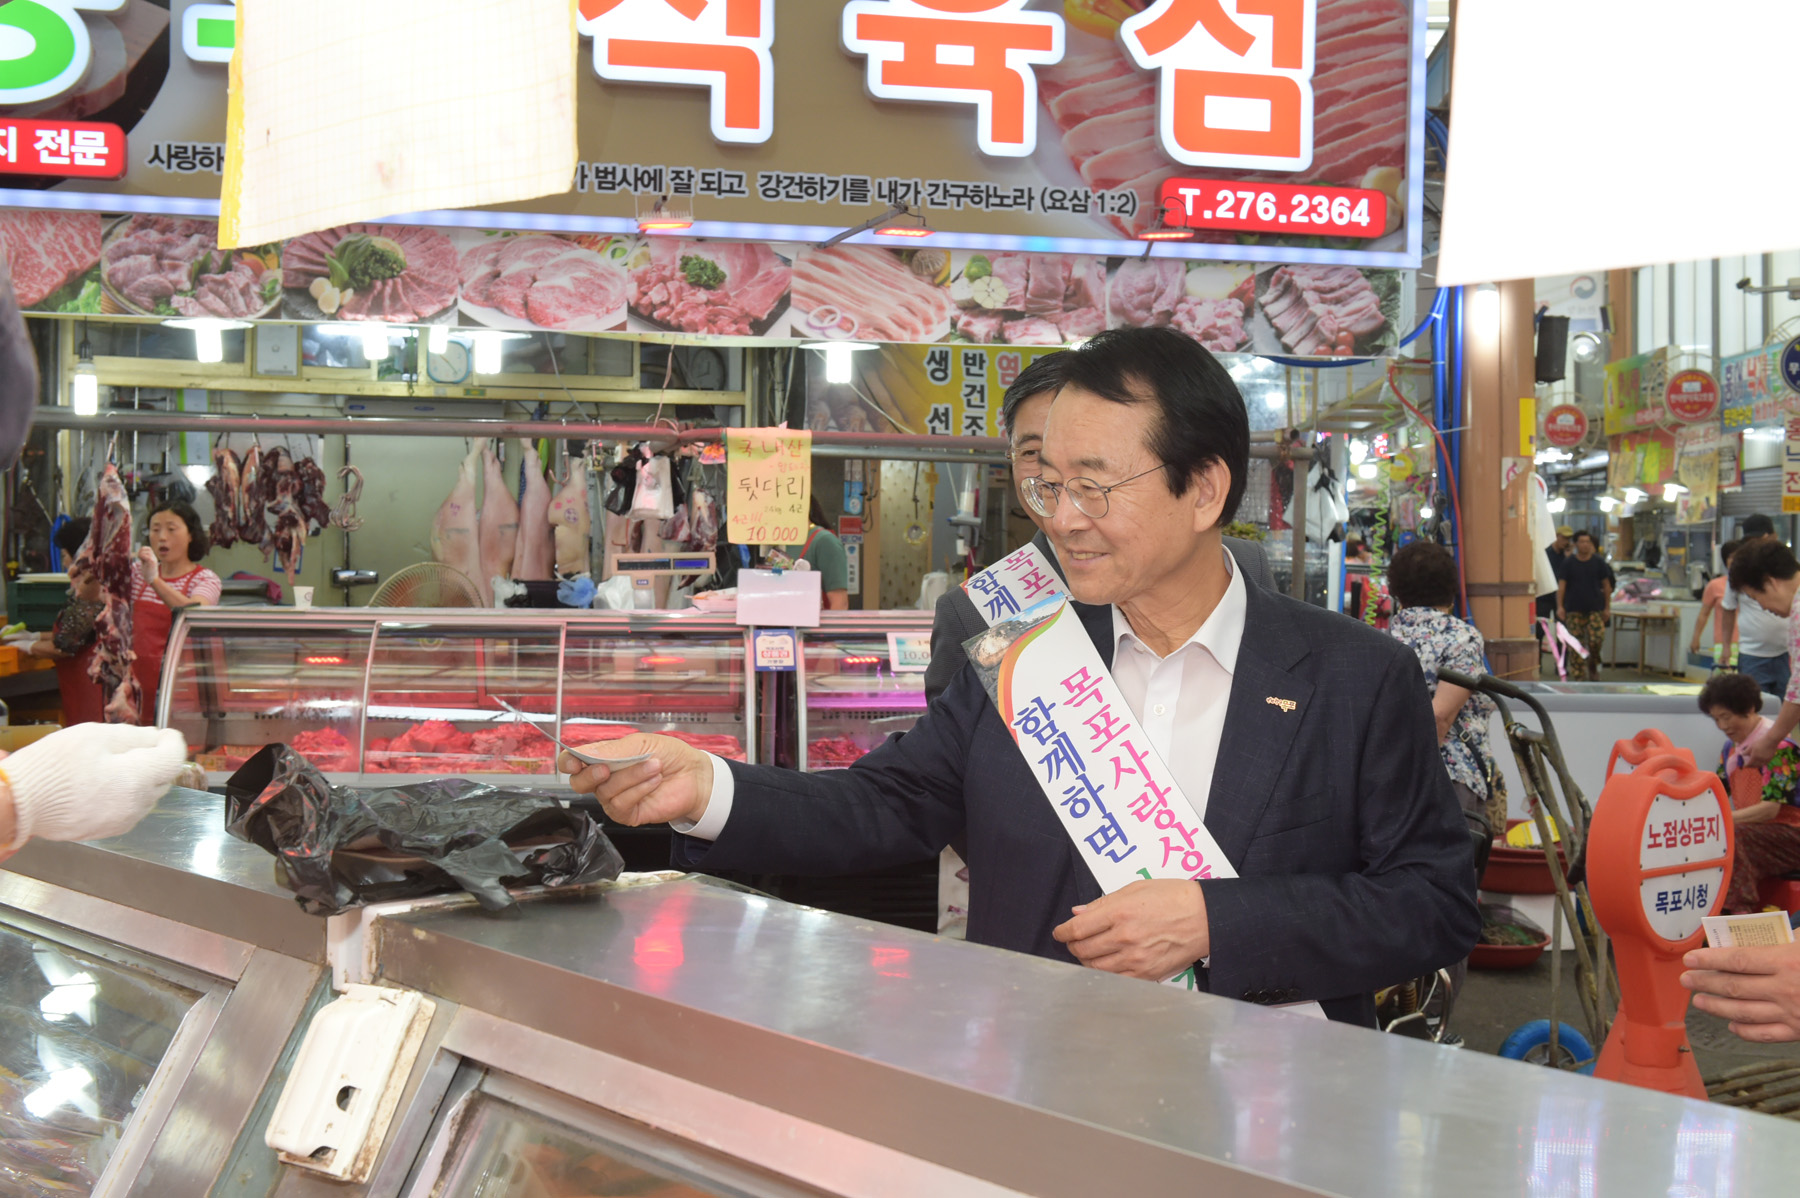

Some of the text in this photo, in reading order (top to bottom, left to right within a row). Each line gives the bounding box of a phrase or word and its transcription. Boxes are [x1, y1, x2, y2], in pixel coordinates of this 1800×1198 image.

[33, 128, 109, 166] 전문
[594, 165, 663, 192] 범사에
[669, 168, 694, 194] 잘
[700, 170, 746, 196] 되고
[758, 173, 870, 203] 강건하기를
[877, 179, 922, 206] 내가
[926, 182, 1035, 211] 간구하노라
[1040, 186, 1090, 214] (요삼
[1097, 190, 1138, 217] 1:2)
[1178, 187, 1370, 227] T.276.2364
[738, 439, 804, 458] 국내산
[738, 475, 804, 501] 뒷다리
[1002, 549, 1056, 600] 목포
[967, 570, 1021, 621] 함께
[1013, 696, 1137, 863] 함께하면
[1060, 666, 1221, 880] 목포사랑상
[1647, 814, 1719, 849] 노점상금지
[1655, 883, 1709, 915] 목포시청
